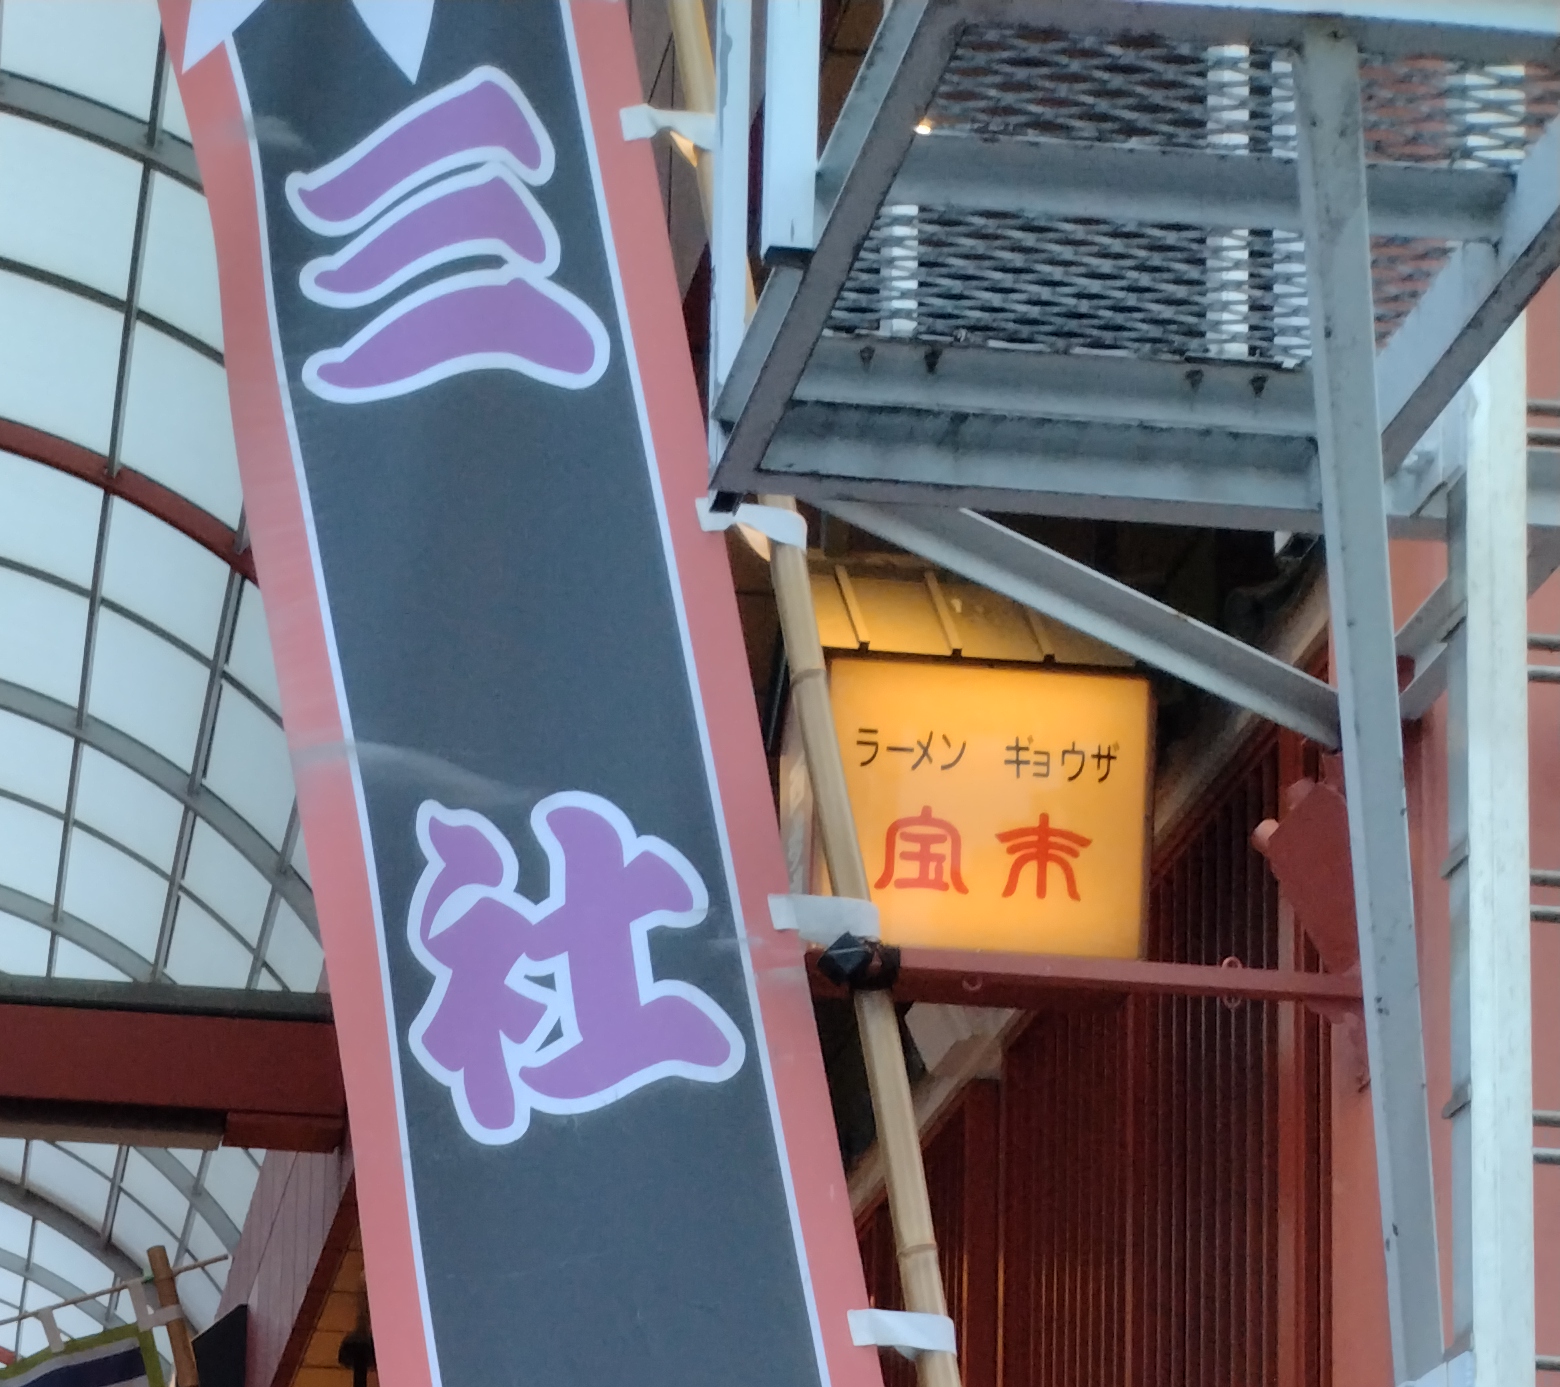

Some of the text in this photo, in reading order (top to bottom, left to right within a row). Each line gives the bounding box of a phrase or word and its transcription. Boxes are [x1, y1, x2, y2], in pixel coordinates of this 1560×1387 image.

[856, 728, 1120, 783] ラーメン ギョウザ
